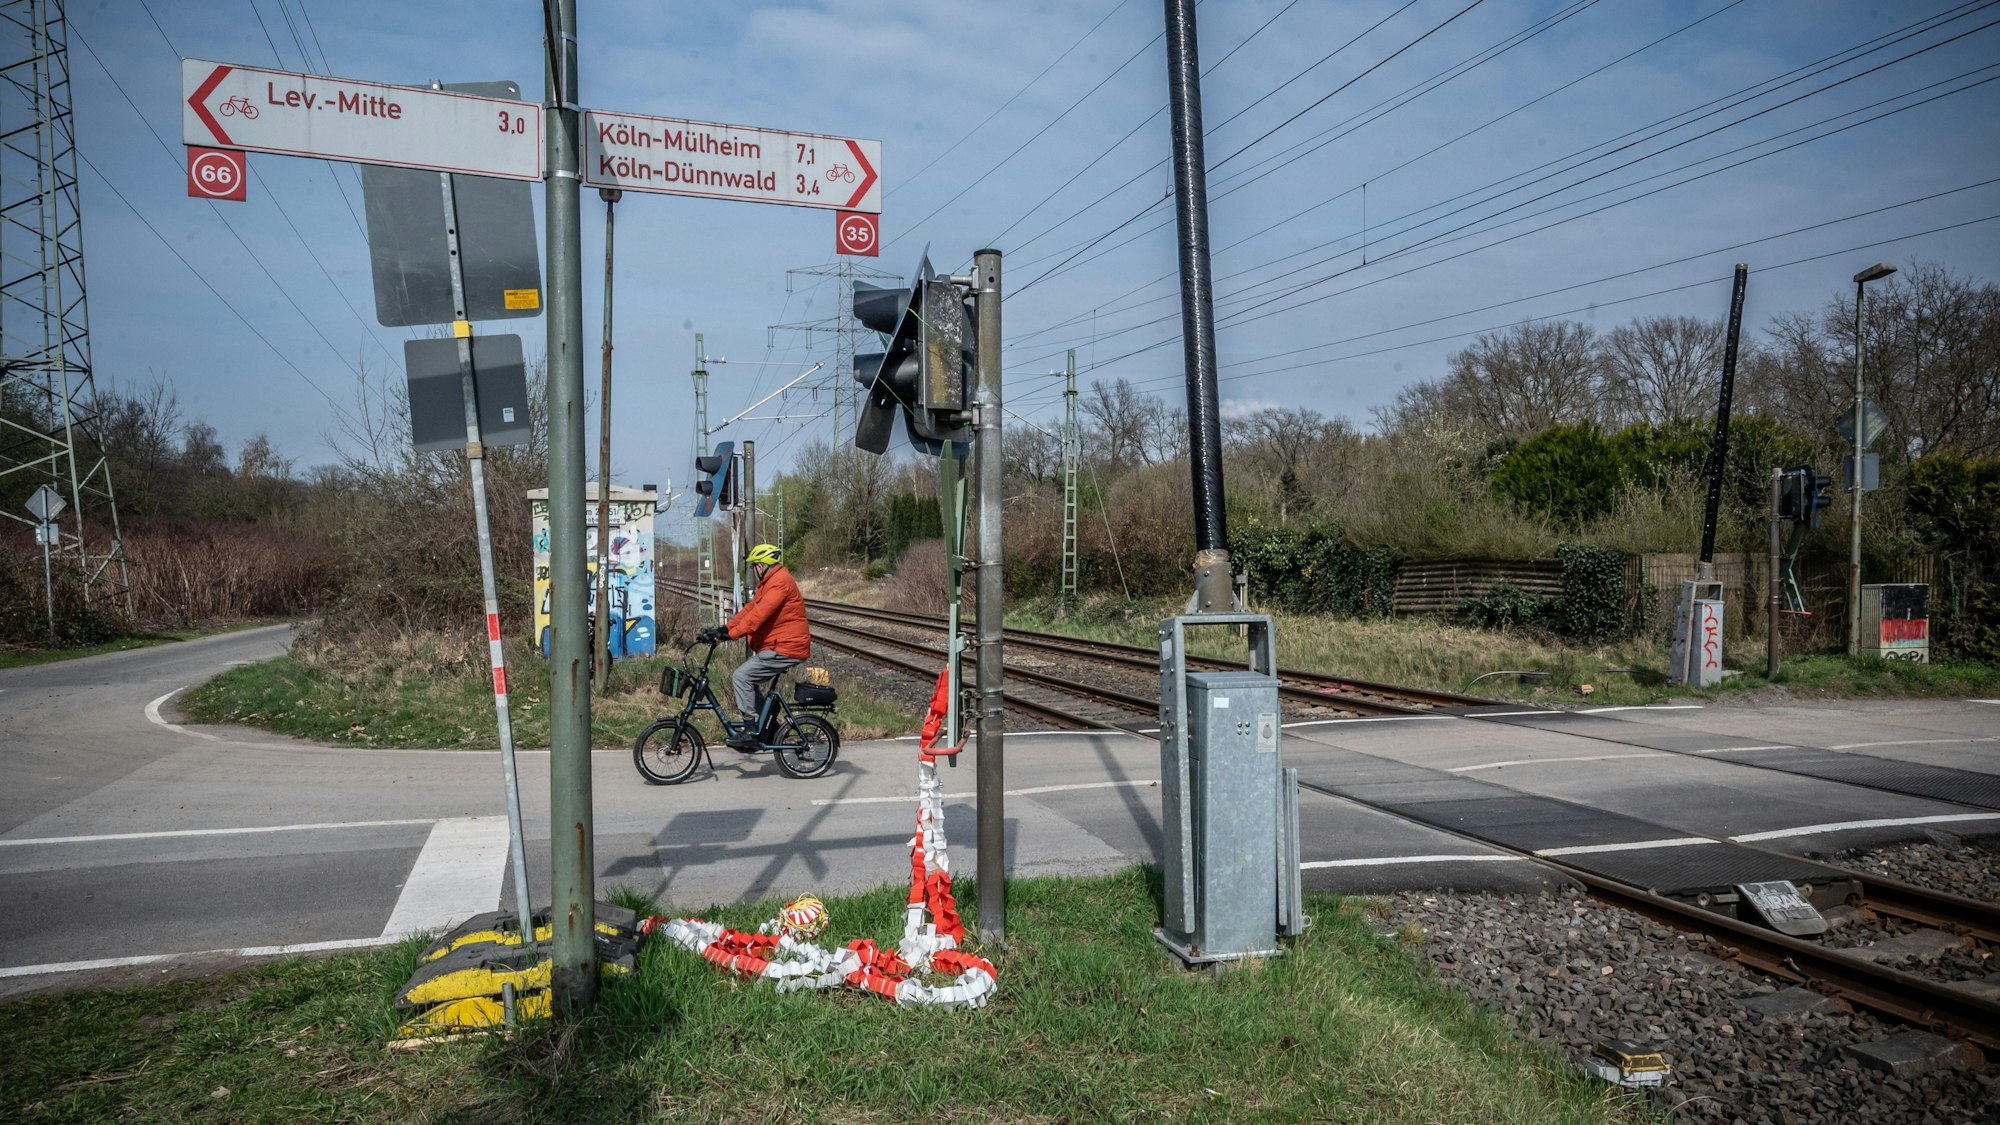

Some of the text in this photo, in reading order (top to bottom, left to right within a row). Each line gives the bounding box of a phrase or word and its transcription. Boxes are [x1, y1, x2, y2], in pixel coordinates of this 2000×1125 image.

[268, 81, 525, 135] Lev.-Mitte 3,0
[599, 122, 815, 166] Köln-Mülheim 7,1
[201, 164, 232, 184] 66
[599, 154, 820, 196] Köln-Dünnwald 3,4
[846, 226, 869, 243] 35
